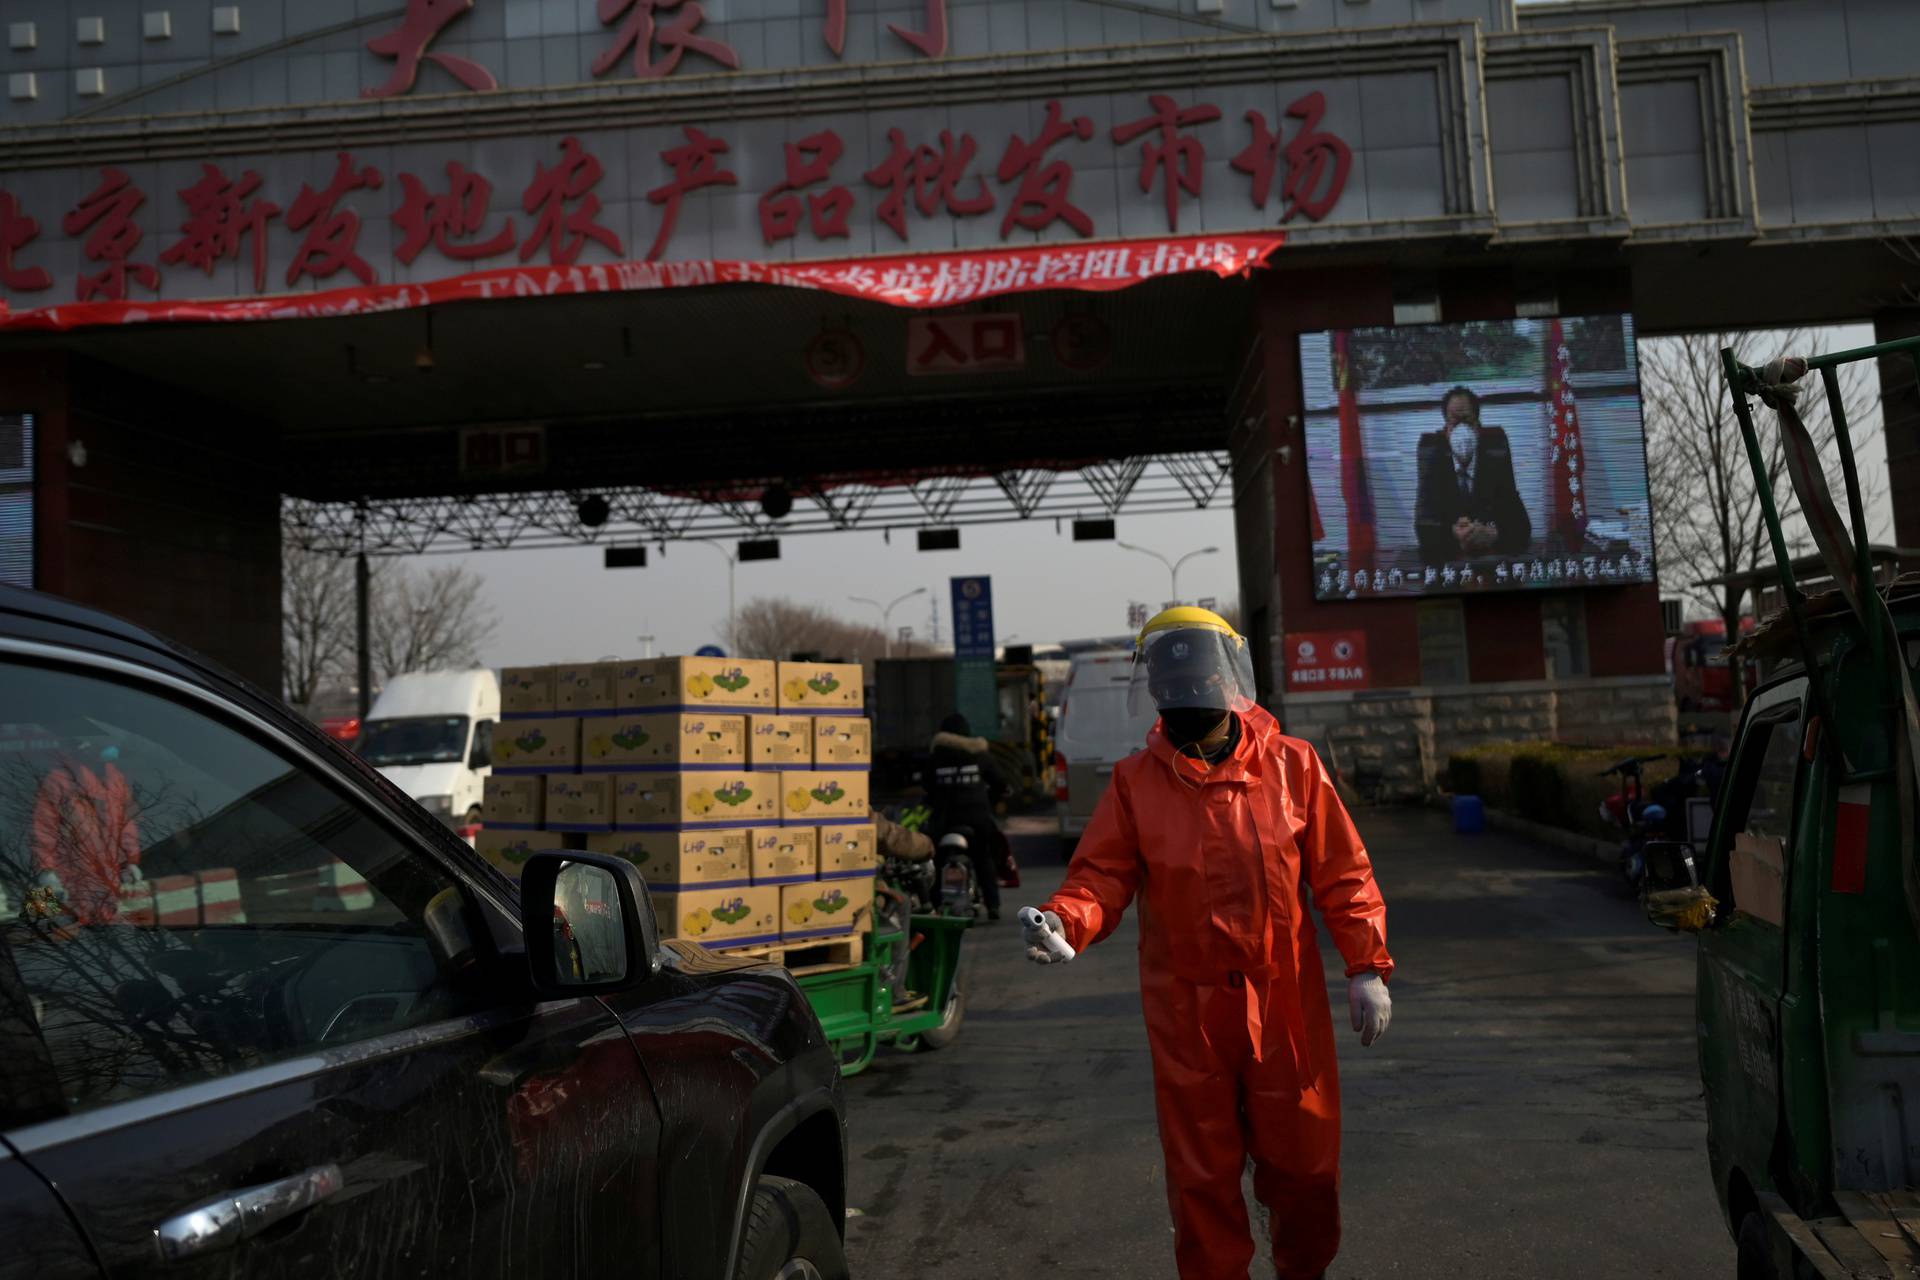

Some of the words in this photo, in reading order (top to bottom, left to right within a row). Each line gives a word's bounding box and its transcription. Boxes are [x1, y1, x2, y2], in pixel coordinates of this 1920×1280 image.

[916, 320, 1016, 365] 入口
[719, 667, 743, 682] LHP
[814, 672, 834, 685] LHP
[684, 721, 705, 735] LHP
[755, 723, 775, 735] LHP
[722, 780, 745, 796] LHP
[817, 780, 839, 794] LHP
[757, 836, 778, 850] LHP
[824, 832, 844, 845] LHP
[683, 840, 706, 853] LHP
[820, 889, 842, 903] LHP
[720, 897, 743, 913] LHP
